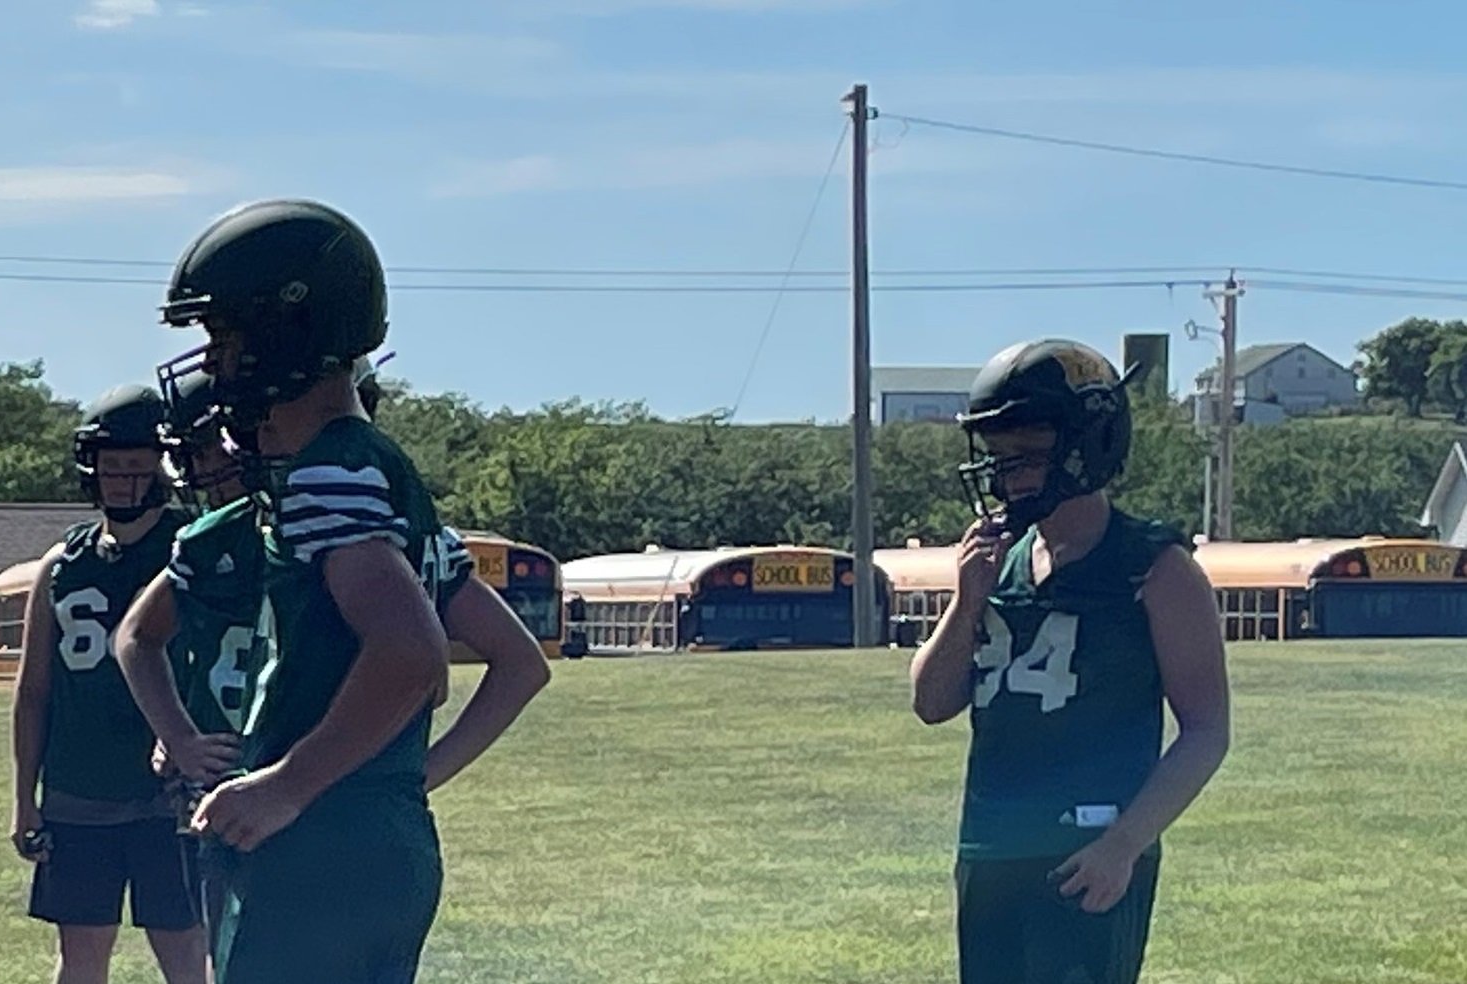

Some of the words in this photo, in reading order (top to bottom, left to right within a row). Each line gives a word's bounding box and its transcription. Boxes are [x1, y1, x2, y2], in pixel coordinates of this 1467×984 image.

[478, 555, 504, 575] BUS
[1372, 552, 1422, 573] SCHOOL
[1427, 553, 1453, 573] BUS
[755, 565, 803, 585] SCHOOL
[807, 565, 833, 585] BUS
[55, 586, 109, 670] 6
